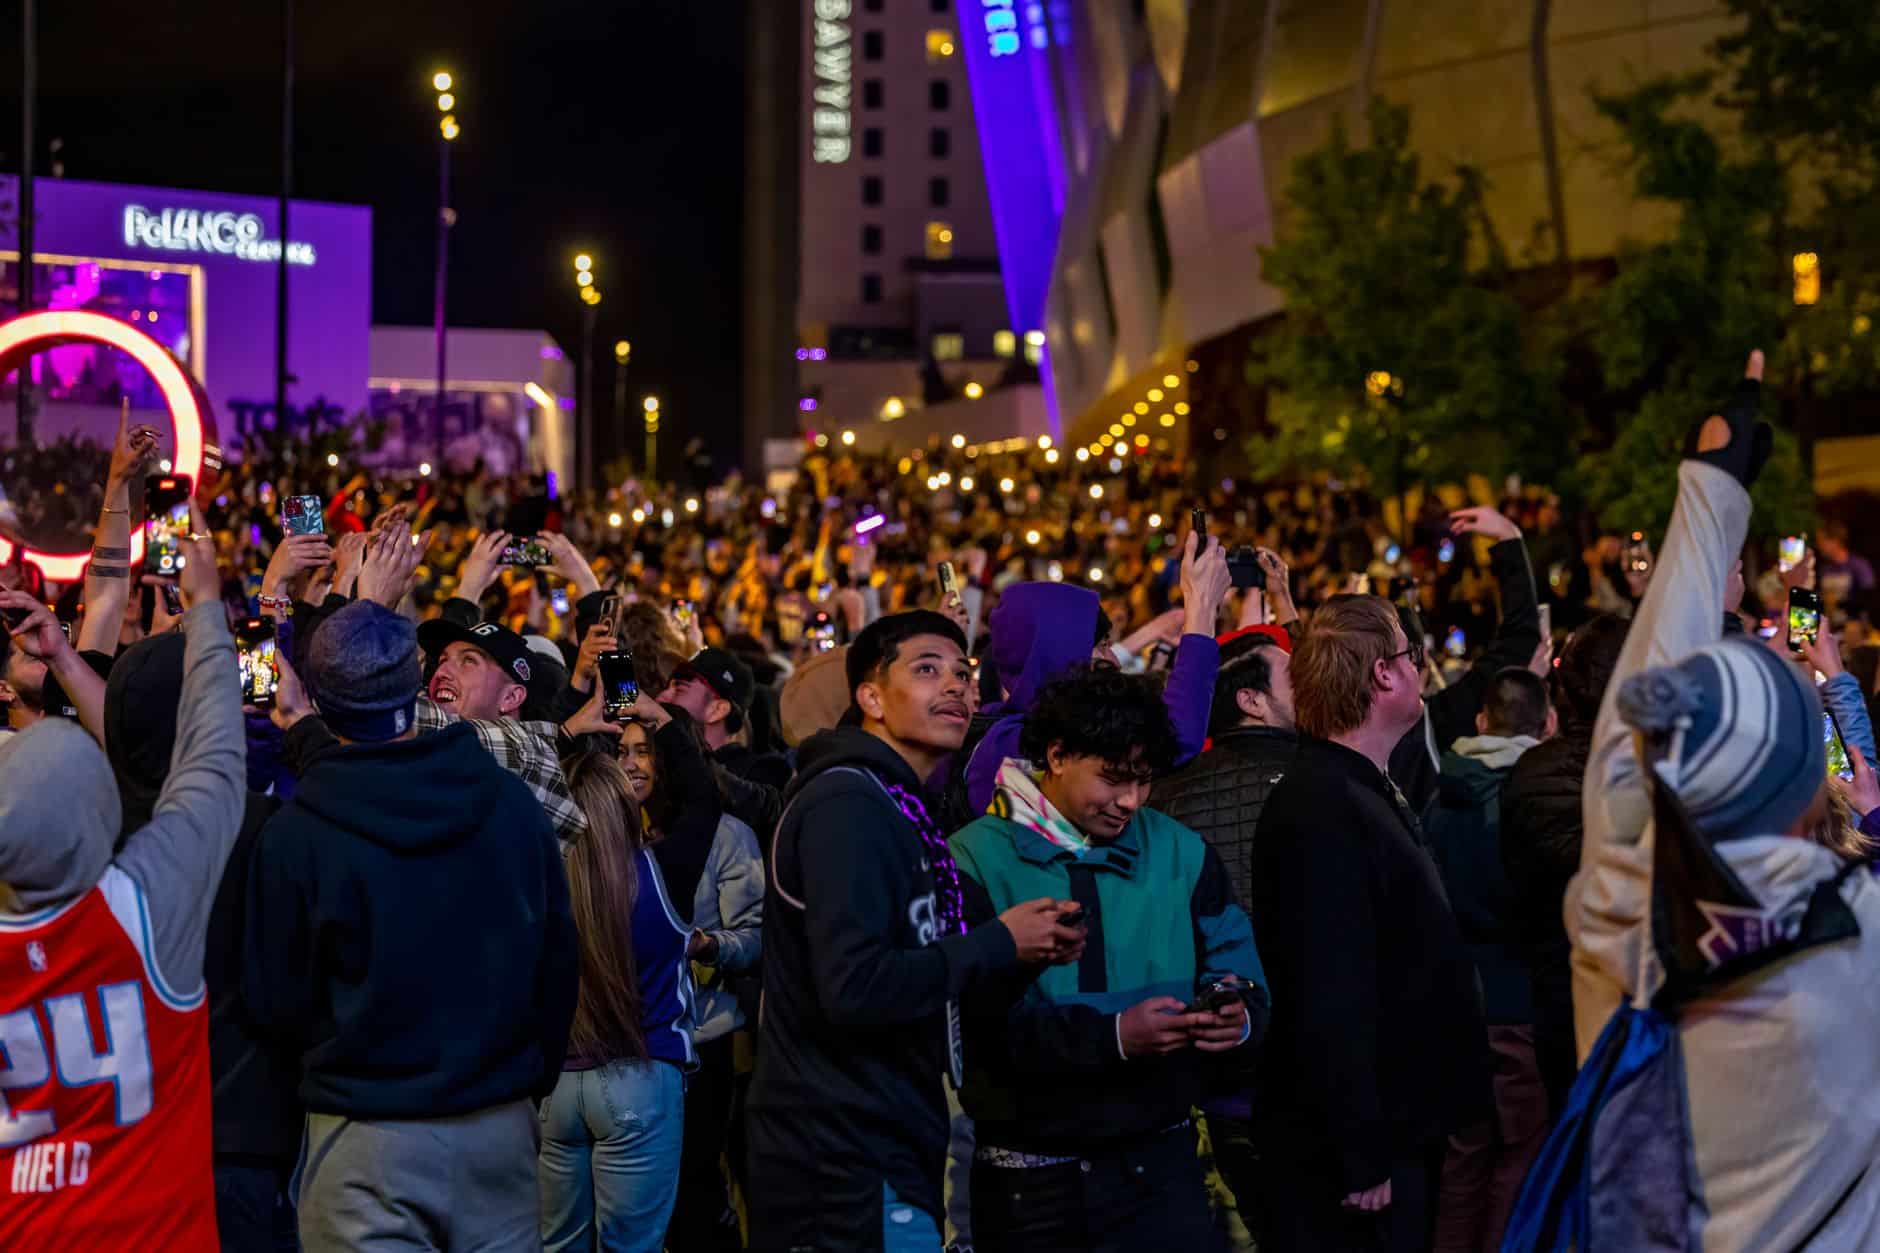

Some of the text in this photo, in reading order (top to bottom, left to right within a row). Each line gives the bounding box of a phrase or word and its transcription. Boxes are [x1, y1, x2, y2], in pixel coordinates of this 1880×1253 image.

[813, 0, 851, 163] SAWYER
[0, 980, 153, 1147] 24
[11, 1141, 92, 1193] HIELD
